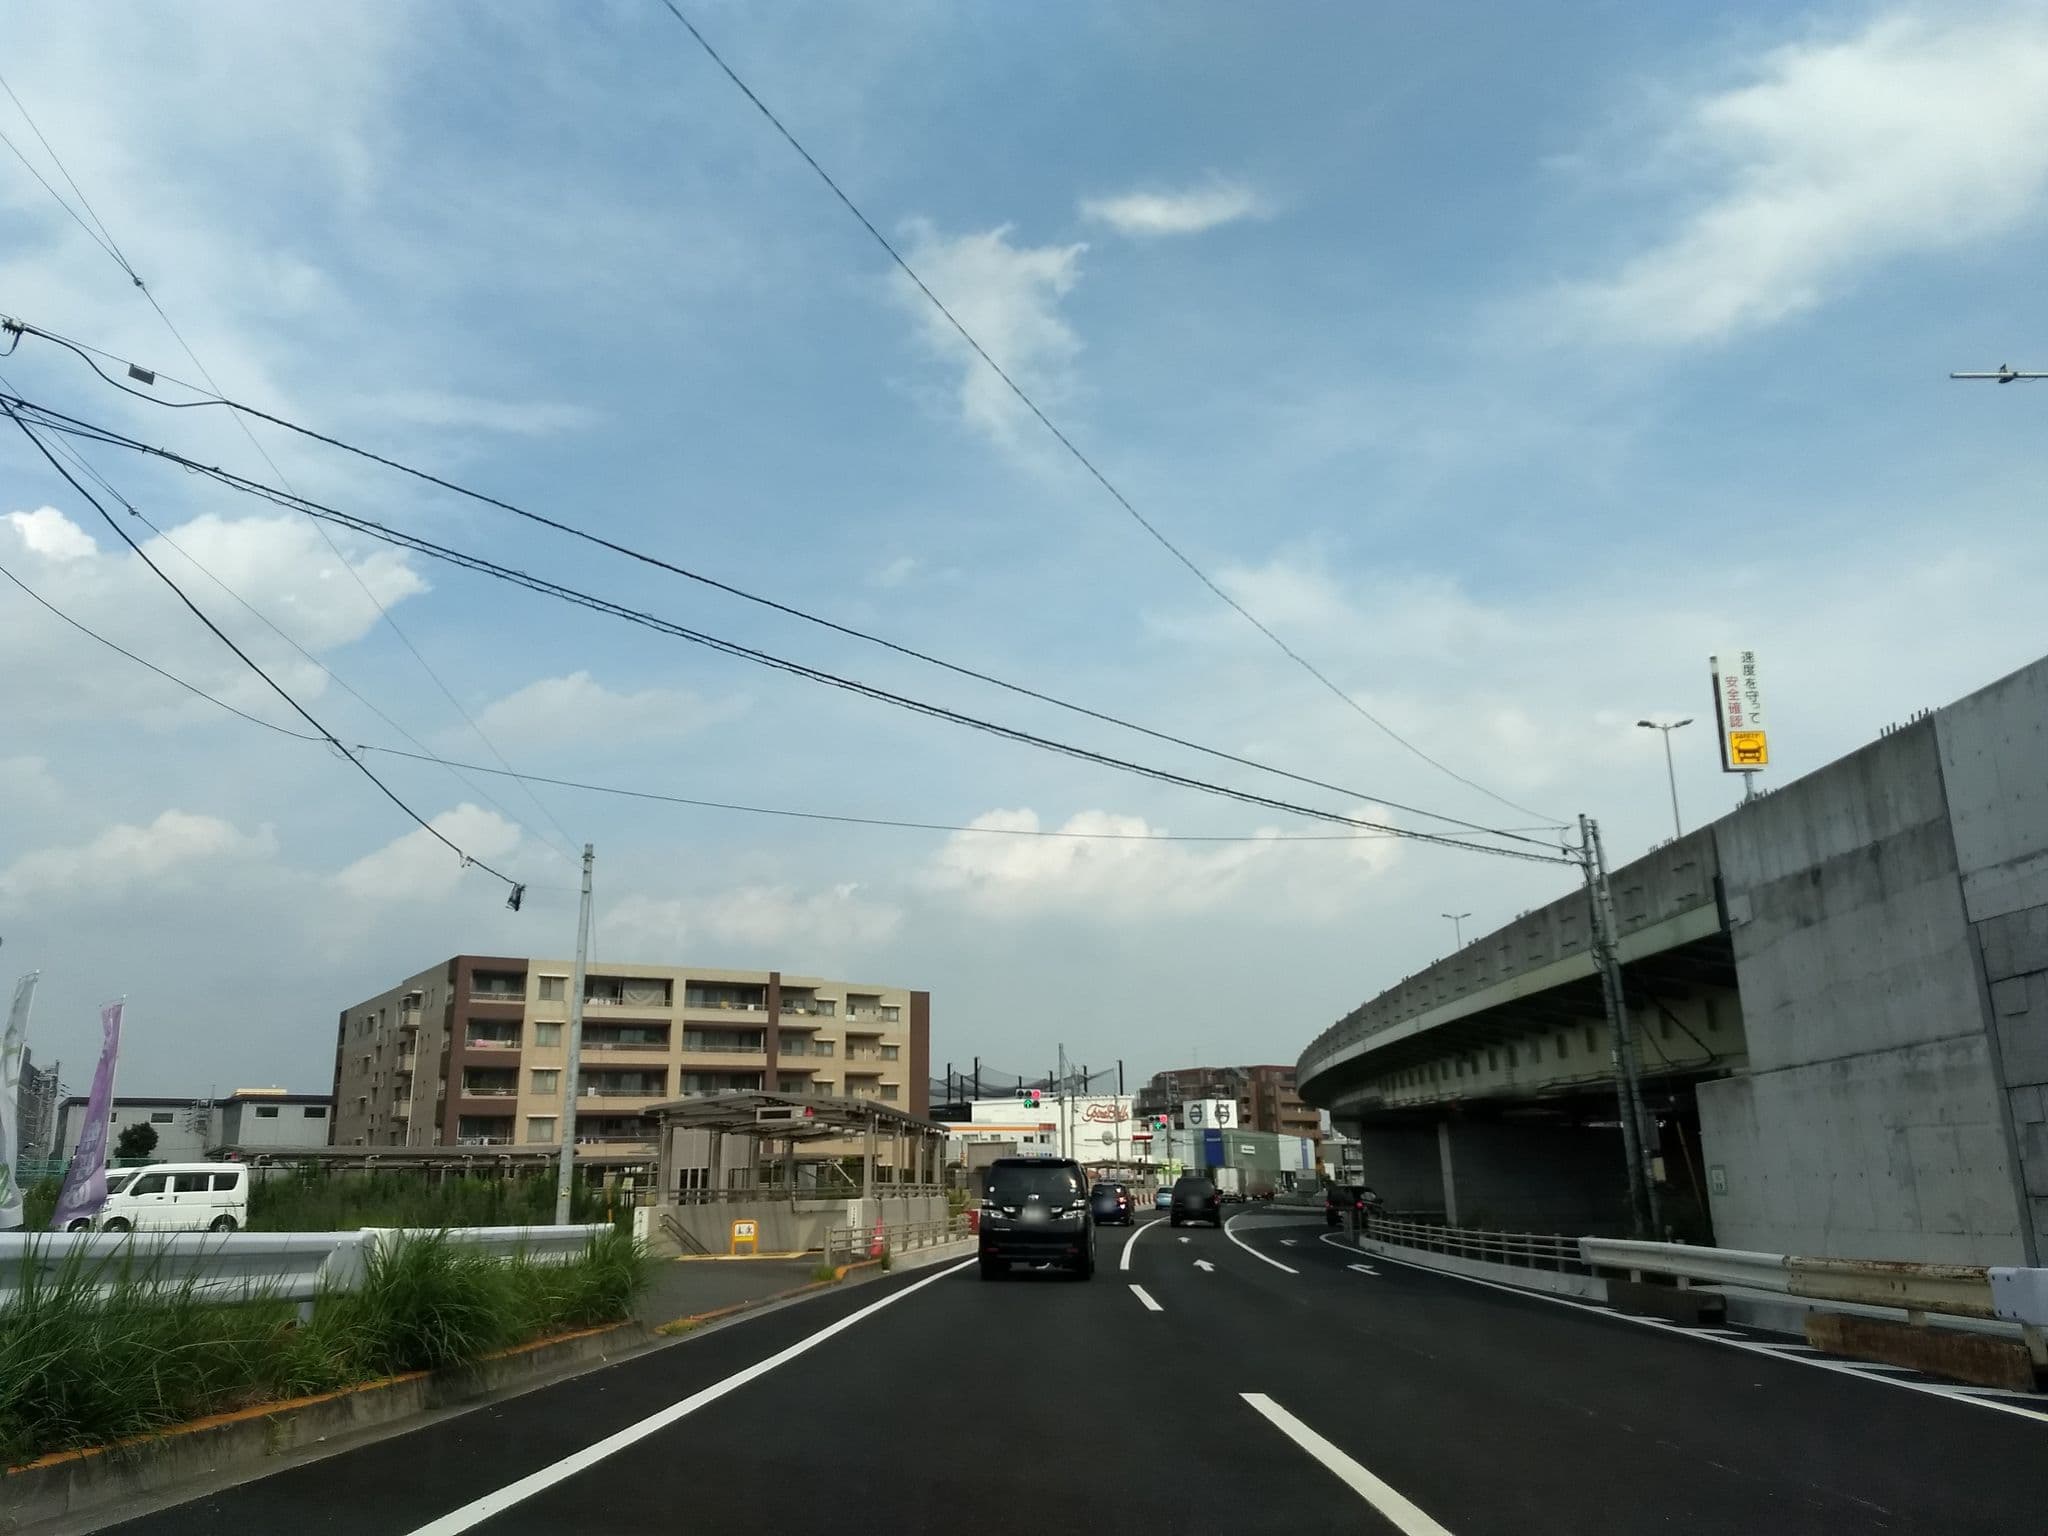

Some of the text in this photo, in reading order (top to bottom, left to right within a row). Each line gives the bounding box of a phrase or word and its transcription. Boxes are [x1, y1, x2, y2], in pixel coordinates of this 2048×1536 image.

[1725, 676, 1744, 728] 安全確認
[1740, 651, 1761, 724] 速度を守って
